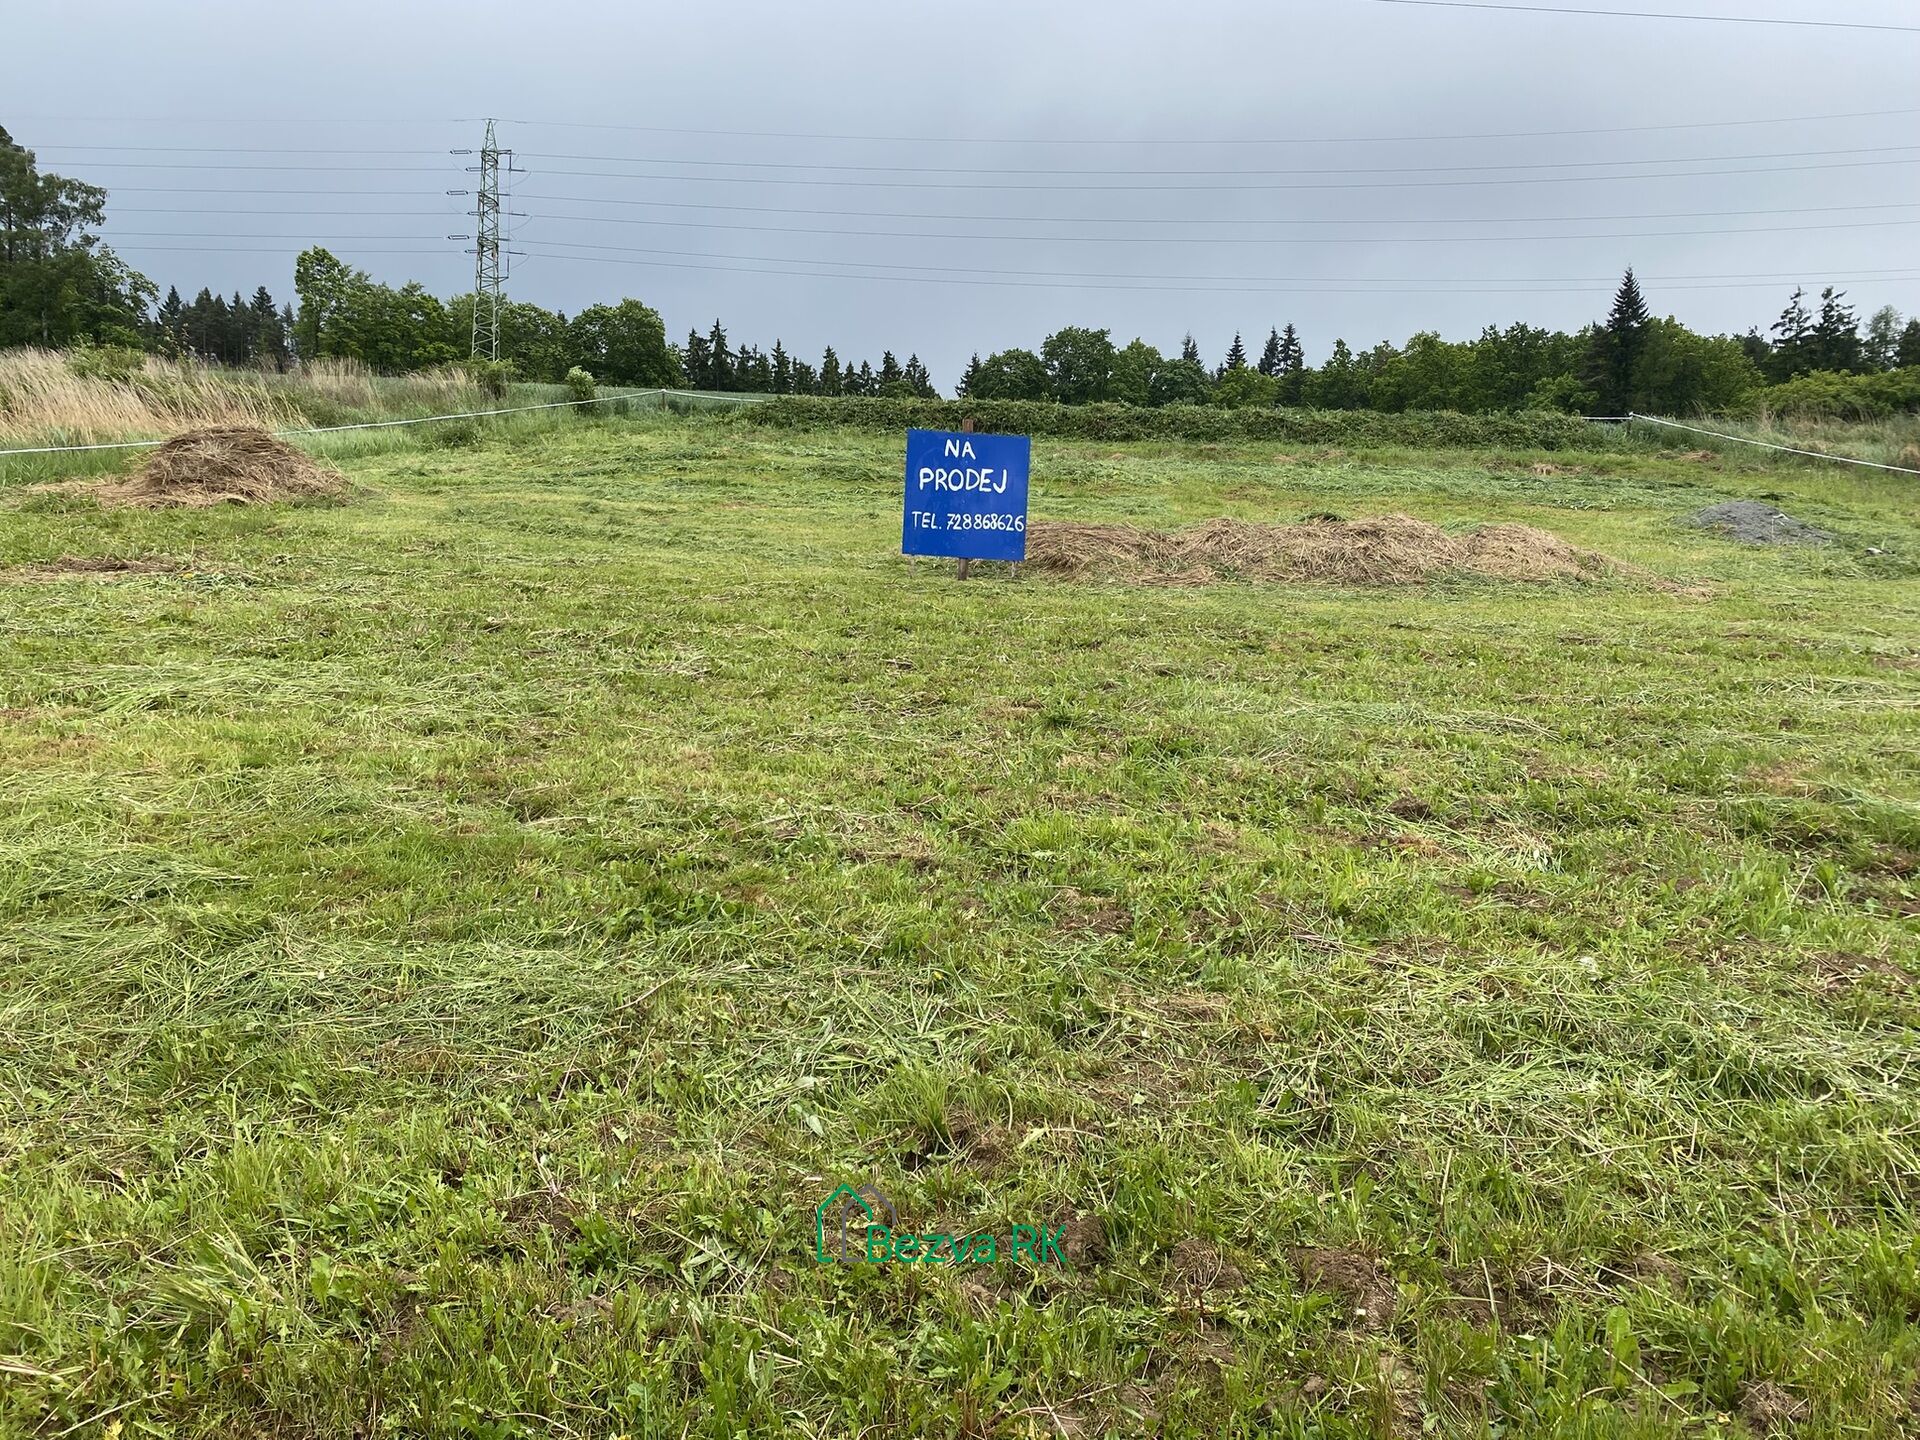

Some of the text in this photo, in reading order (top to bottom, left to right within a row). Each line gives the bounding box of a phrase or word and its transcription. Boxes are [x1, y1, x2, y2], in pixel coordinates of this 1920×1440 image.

[944, 439, 976, 460] NA
[919, 467, 1008, 494] PRODEJ
[911, 511, 1025, 532] TEL. 728868626
